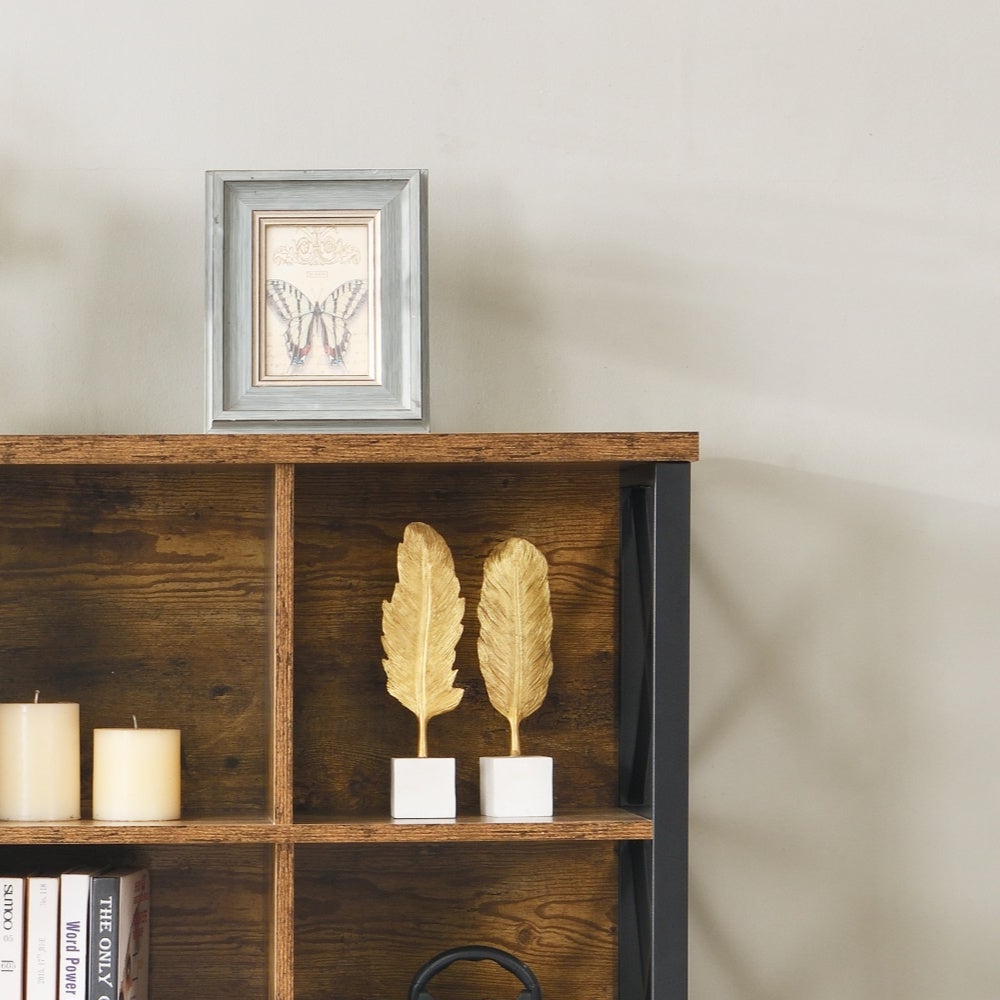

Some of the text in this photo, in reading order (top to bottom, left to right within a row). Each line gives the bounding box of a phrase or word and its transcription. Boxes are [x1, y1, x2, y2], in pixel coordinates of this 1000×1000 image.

[99, 896, 113, 933] THE
[65, 920, 81, 952] Word
[64, 957, 81, 996] Power
[98, 937, 114, 988] ONLY
